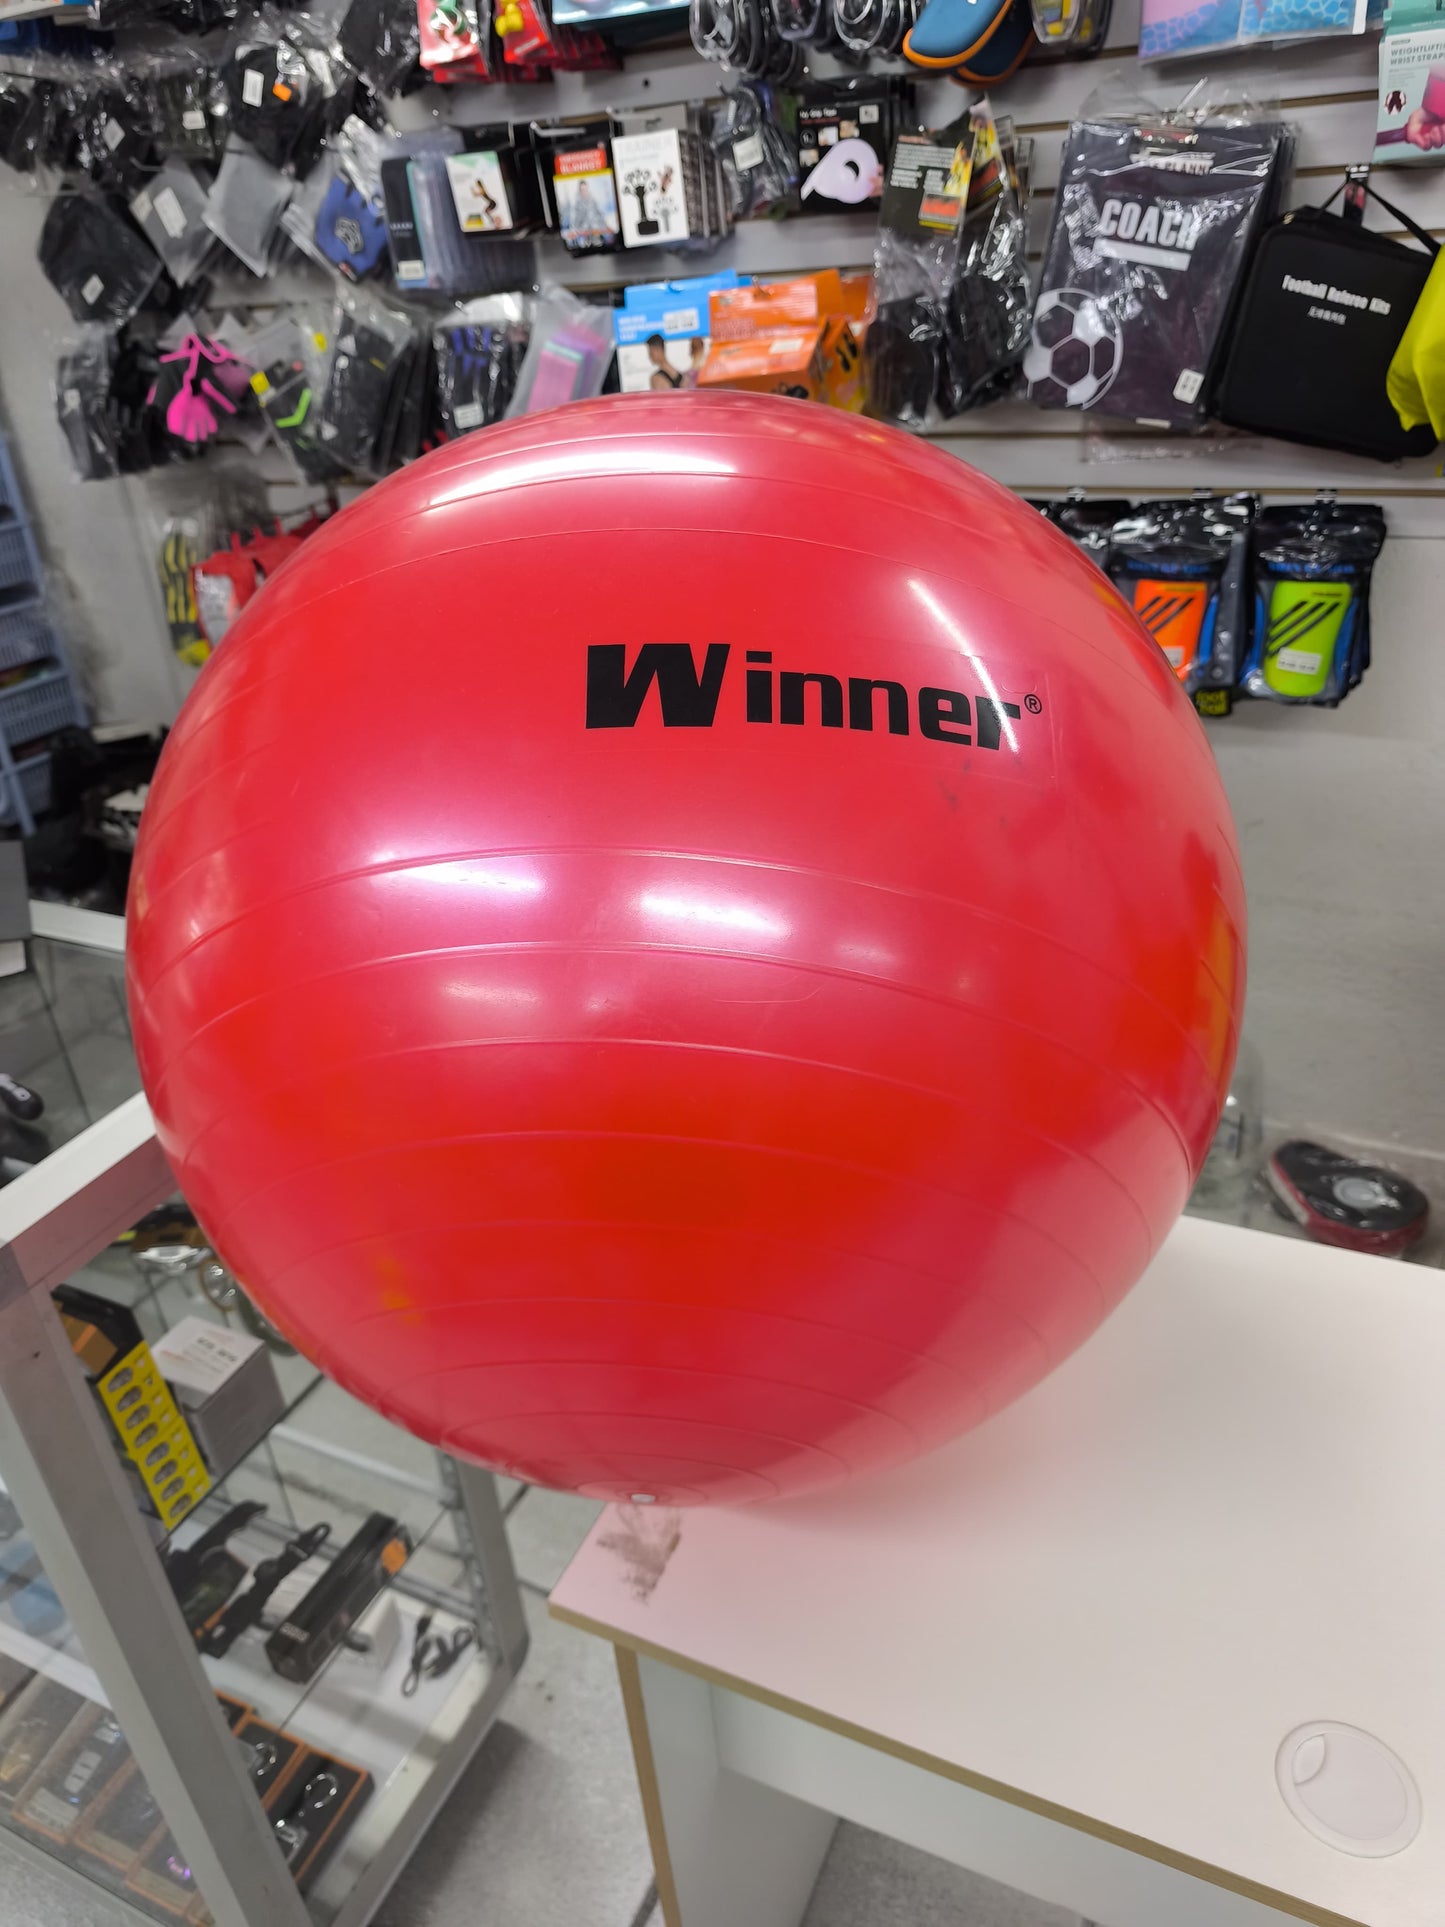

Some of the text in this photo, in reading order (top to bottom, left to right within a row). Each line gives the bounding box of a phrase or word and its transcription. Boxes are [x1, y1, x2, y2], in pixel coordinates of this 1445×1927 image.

[1391, 55, 1415, 65] WRIST
[1100, 199, 1199, 251] COACH
[1282, 274, 1328, 299] Football
[586, 643, 1021, 751] Winner
